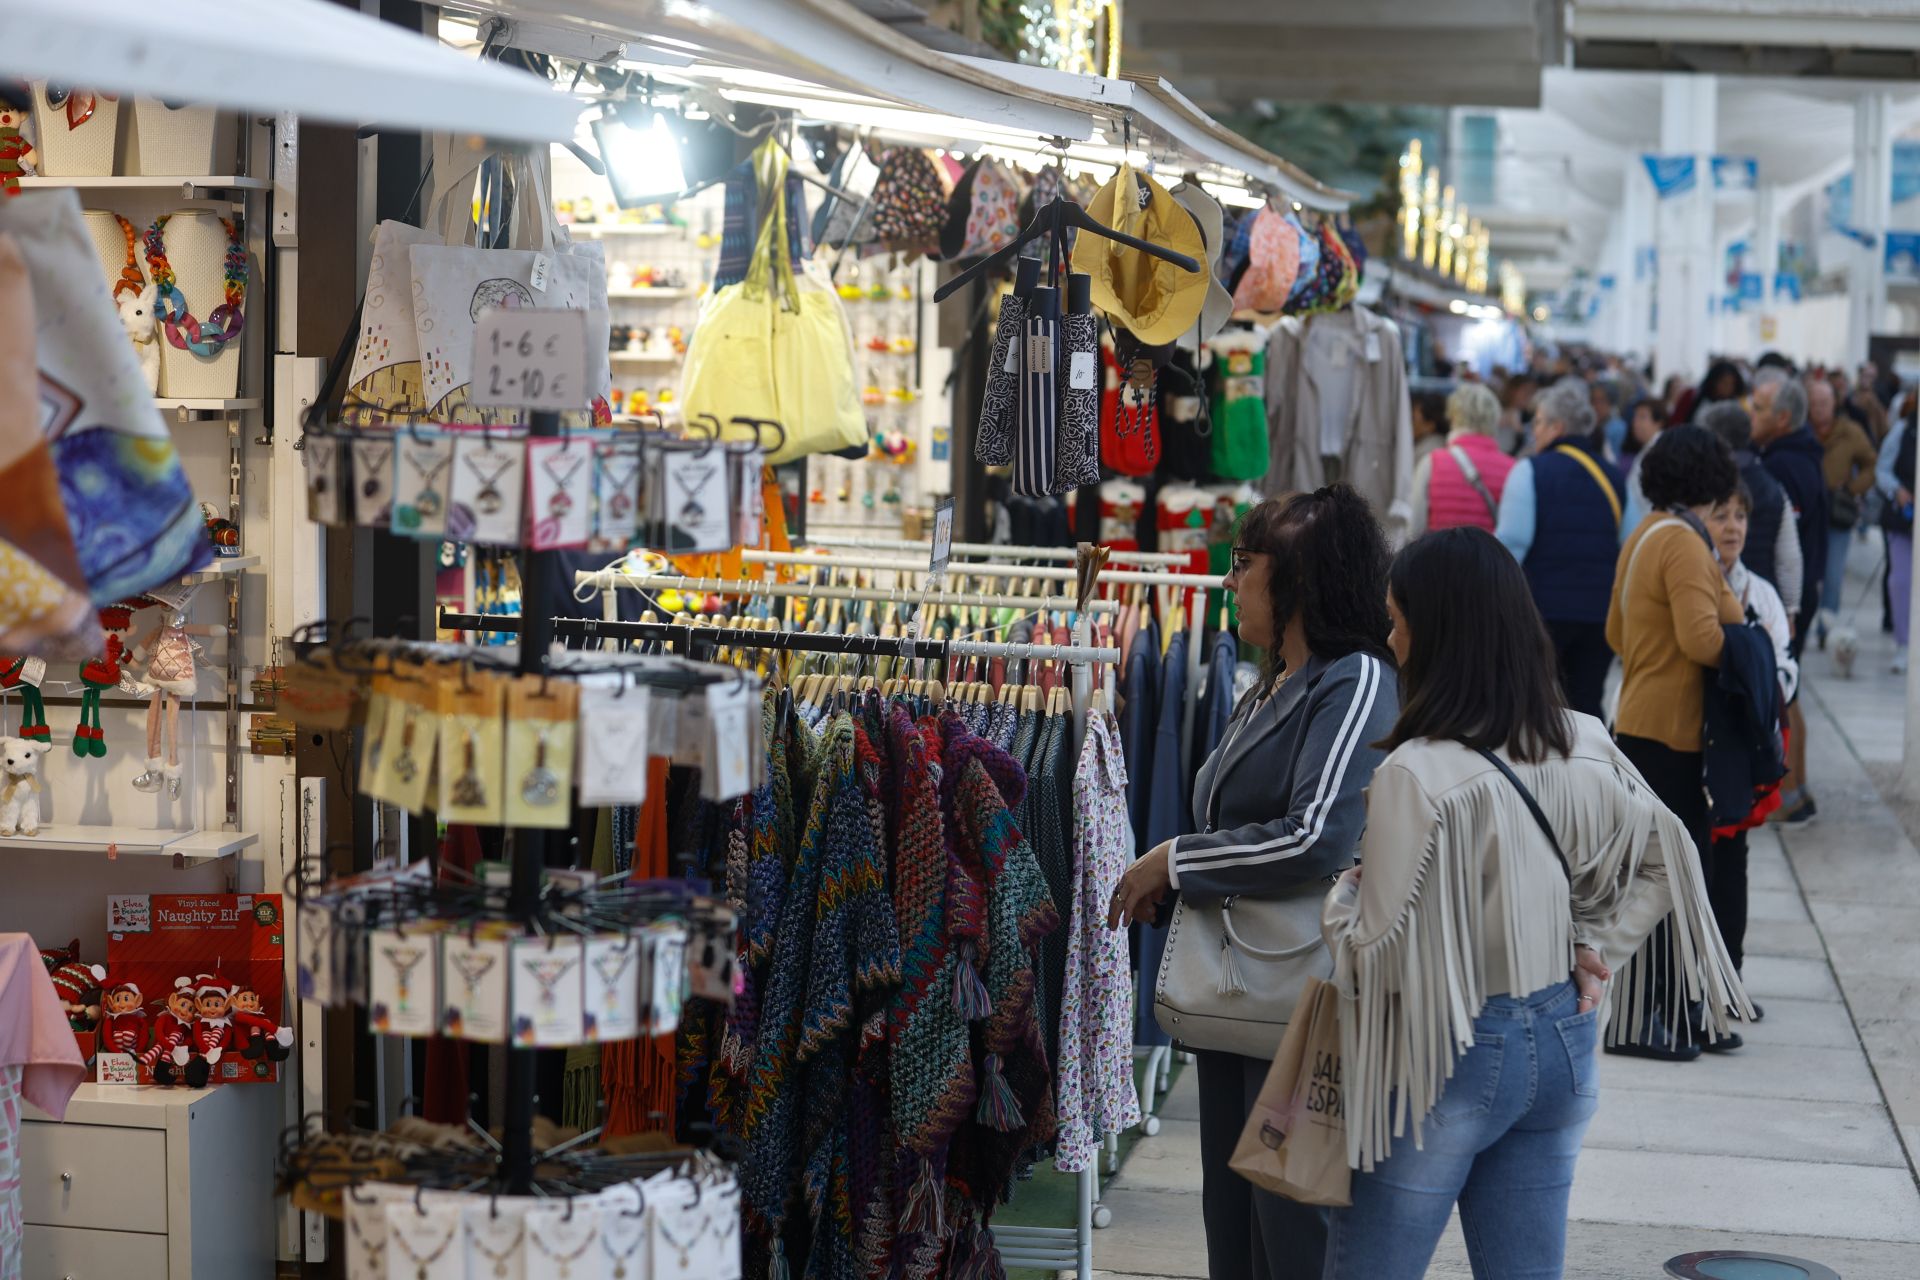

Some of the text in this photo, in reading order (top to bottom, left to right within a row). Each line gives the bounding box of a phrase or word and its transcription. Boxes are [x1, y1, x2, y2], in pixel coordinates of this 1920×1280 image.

[178, 899, 220, 908] Vinyl Faced
[157, 909, 240, 924] Naughty Elf
